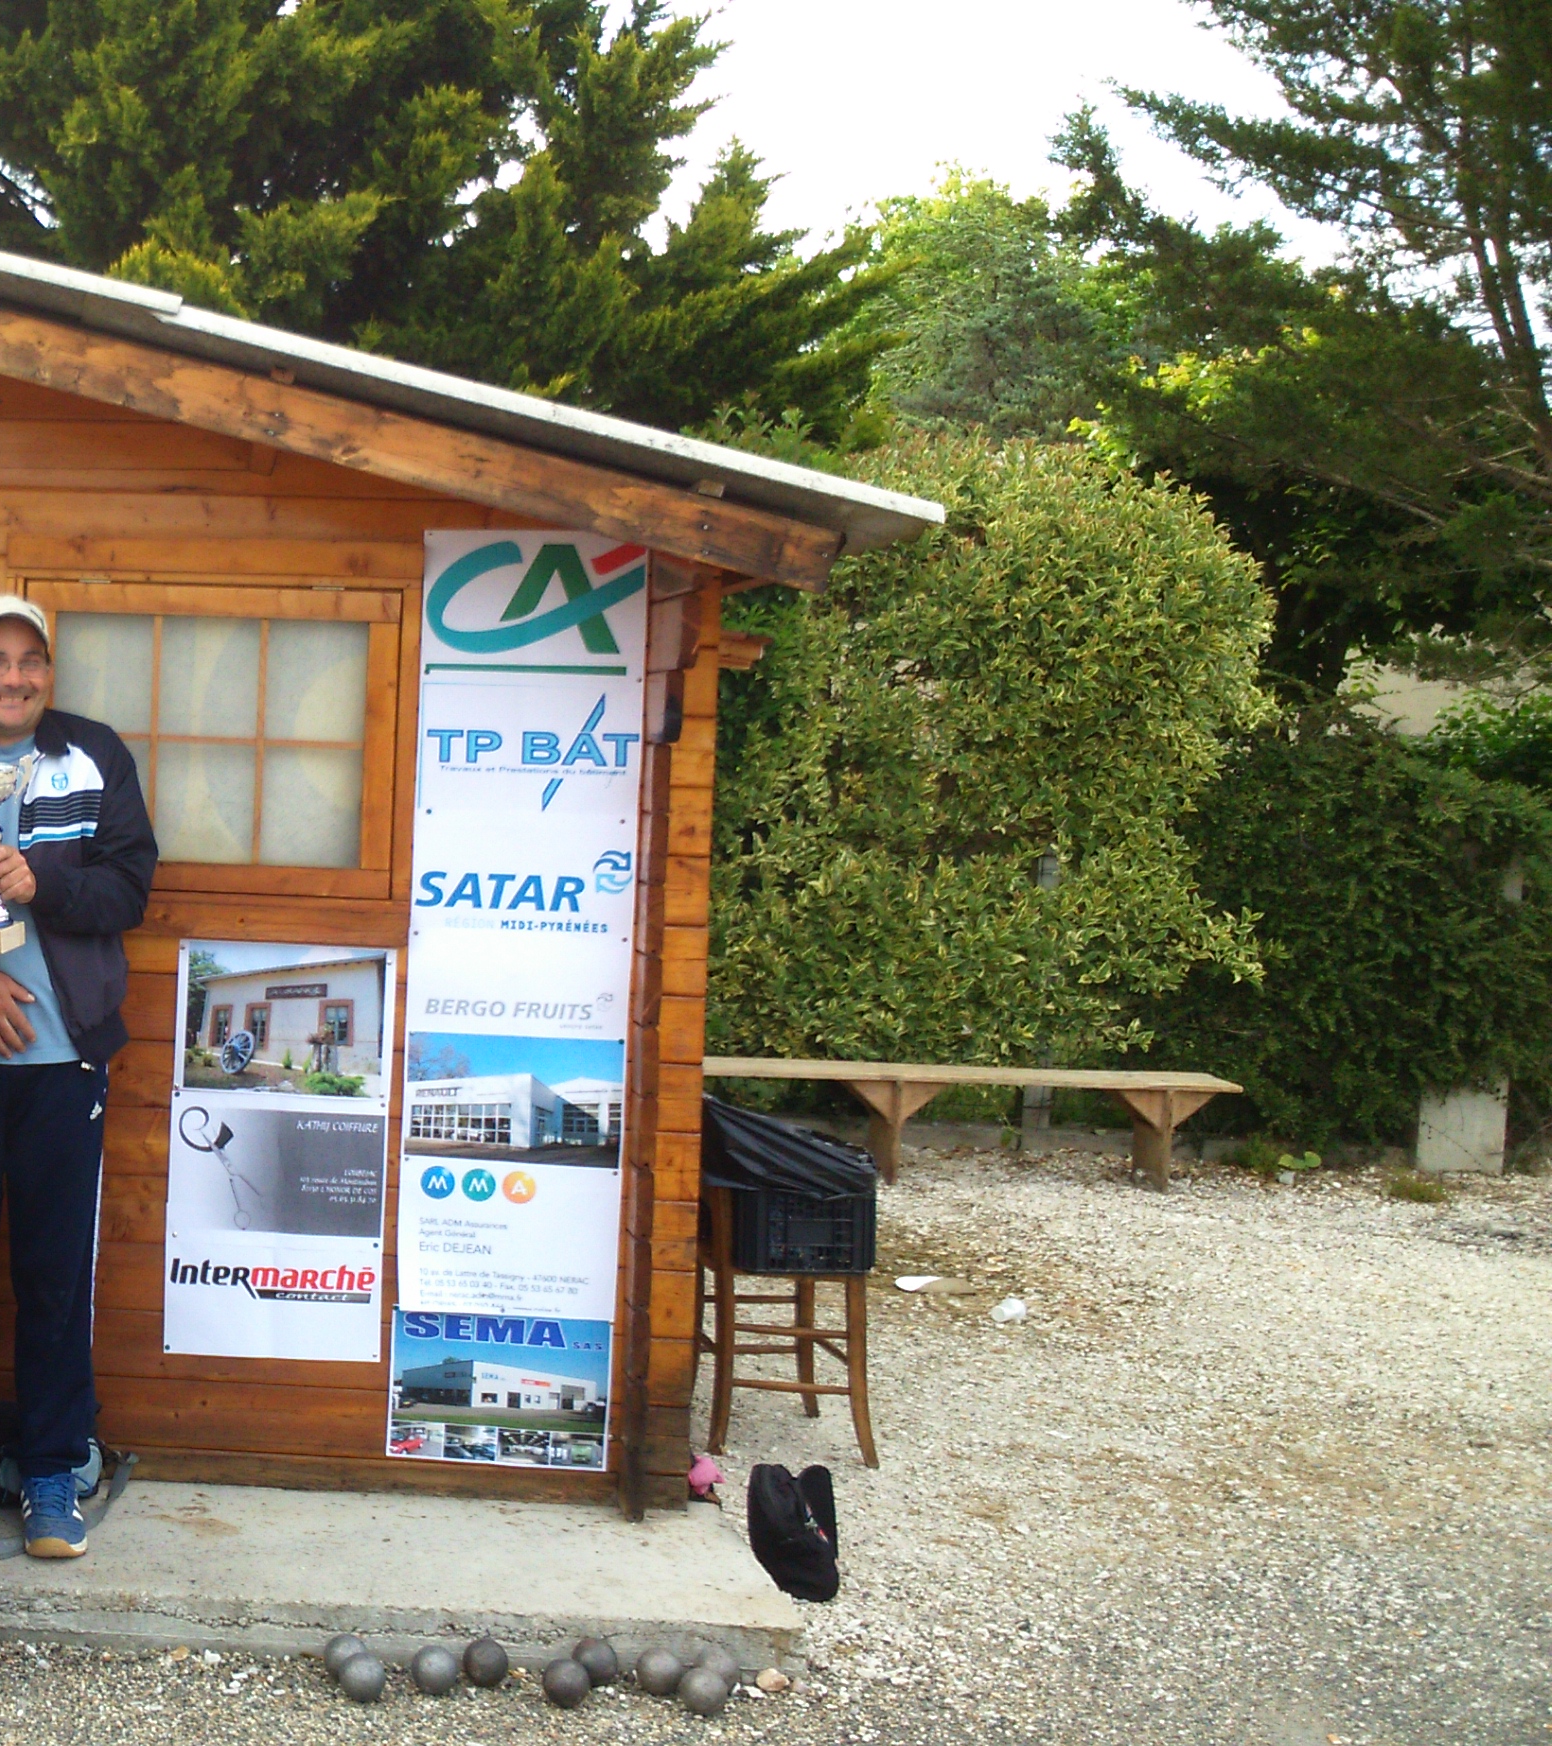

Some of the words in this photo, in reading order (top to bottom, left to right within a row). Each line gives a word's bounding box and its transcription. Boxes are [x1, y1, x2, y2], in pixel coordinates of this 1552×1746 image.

[427, 729, 503, 763] TP
[439, 765, 482, 773] Travaux
[498, 767, 559, 775] Prestations
[414, 871, 586, 913] SATAR
[501, 919, 609, 934] MIDI-PYRÉNÉES
[425, 998, 506, 1017] BERGO
[513, 1001, 592, 1021] FRUITS
[332, 1121, 380, 1134] COIFFURE
[419, 1217, 439, 1227] SARL
[442, 1218, 462, 1227] ADM
[465, 1219, 508, 1230] Assurances
[419, 1229, 443, 1239] Agent
[445, 1229, 476, 1238] Général
[419, 1241, 439, 1252] Eric
[443, 1242, 492, 1255] DEJEAN
[170, 1257, 376, 1299] Intermarché
[420, 1268, 428, 1276] 10
[479, 1270, 490, 1278] de
[492, 1270, 525, 1282] Tassigny
[560, 1276, 590, 1285] NERAC
[274, 1290, 349, 1302] contact
[403, 1311, 567, 1350] SEMA
